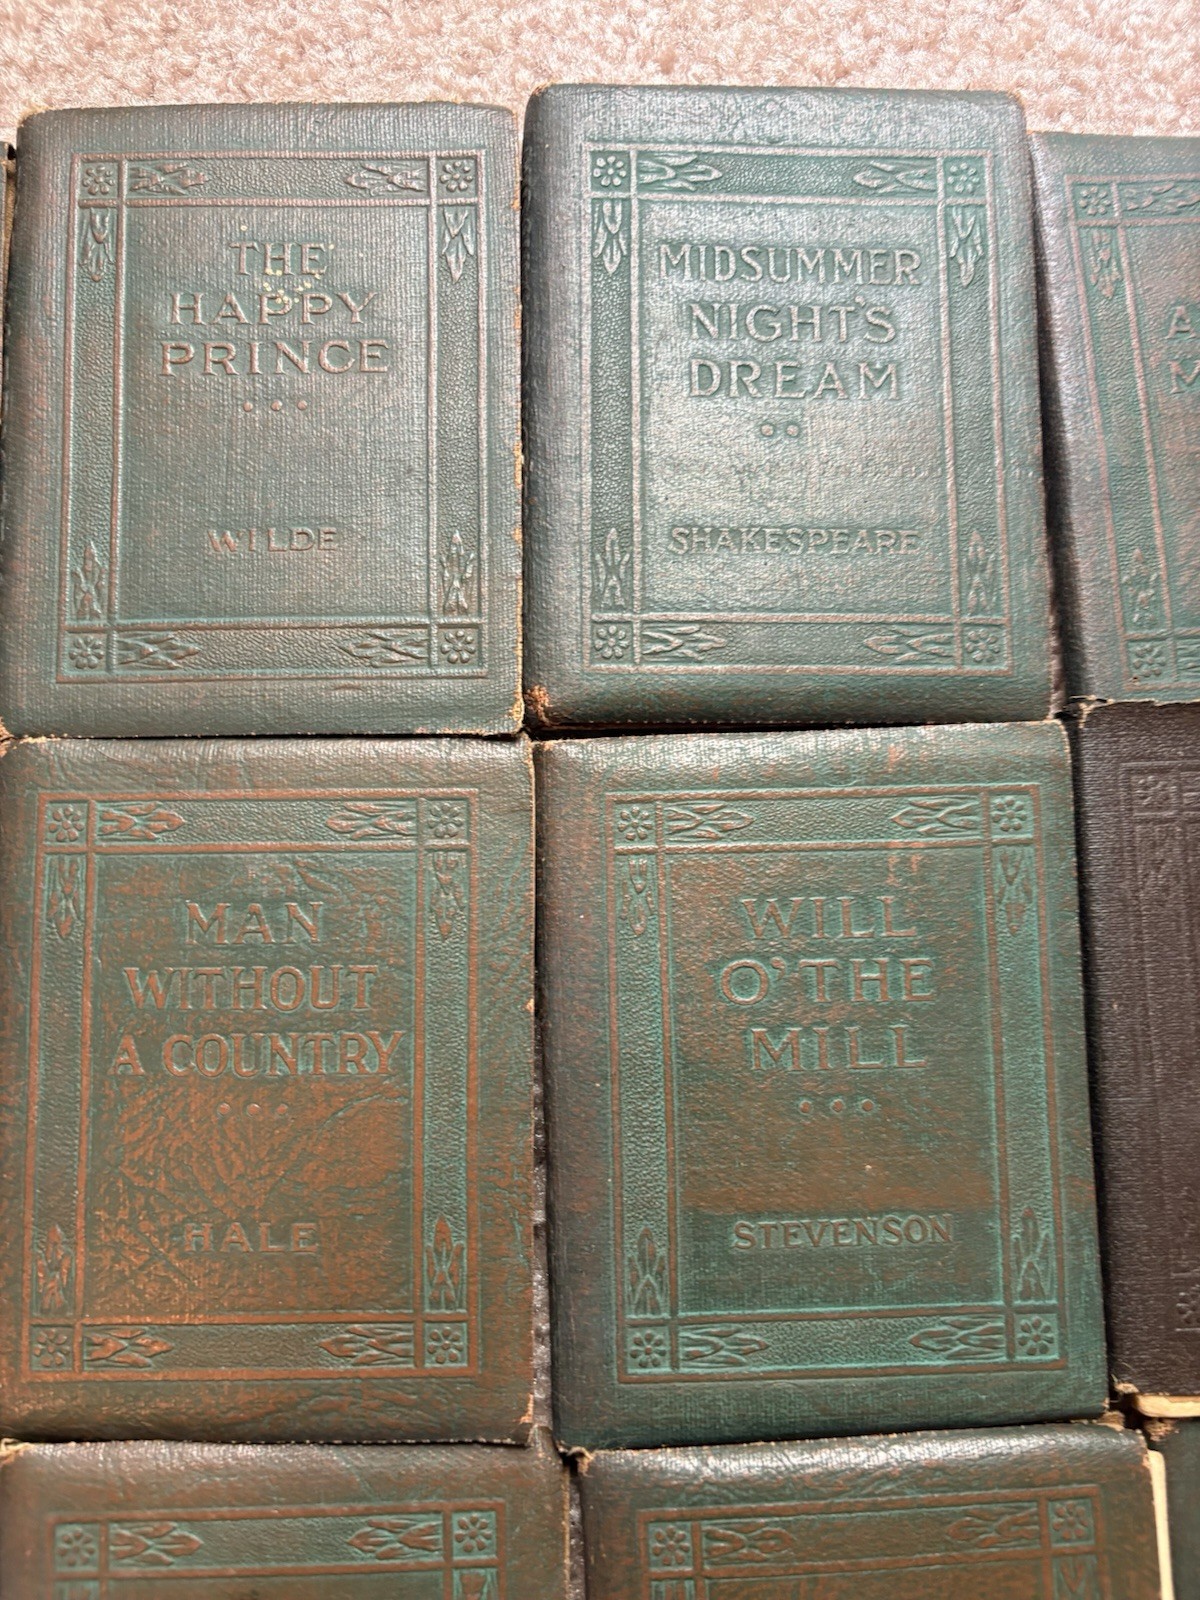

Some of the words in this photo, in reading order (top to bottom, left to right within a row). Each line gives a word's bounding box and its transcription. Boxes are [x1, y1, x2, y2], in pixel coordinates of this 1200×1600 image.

[230, 242, 328, 276] THE
[658, 245, 921, 287] MIDSUMMER
[170, 292, 378, 326] HAPPY
[690, 297, 897, 344] NIGHT'S
[159, 340, 390, 377] PRINCE
[688, 358, 898, 400] DREAM
[207, 527, 338, 553] WILDE
[669, 526, 921, 558] SHAKESPEARE
[184, 901, 325, 945] MAN
[739, 895, 918, 941] WILL
[123, 965, 379, 1013] WITHOUT
[108, 1034, 145, 1078] A
[162, 1030, 404, 1079] COUNTRY
[750, 1024, 928, 1072] MILL
[184, 1222, 320, 1254] HALE
[732, 1214, 956, 1252] STEVENSON
